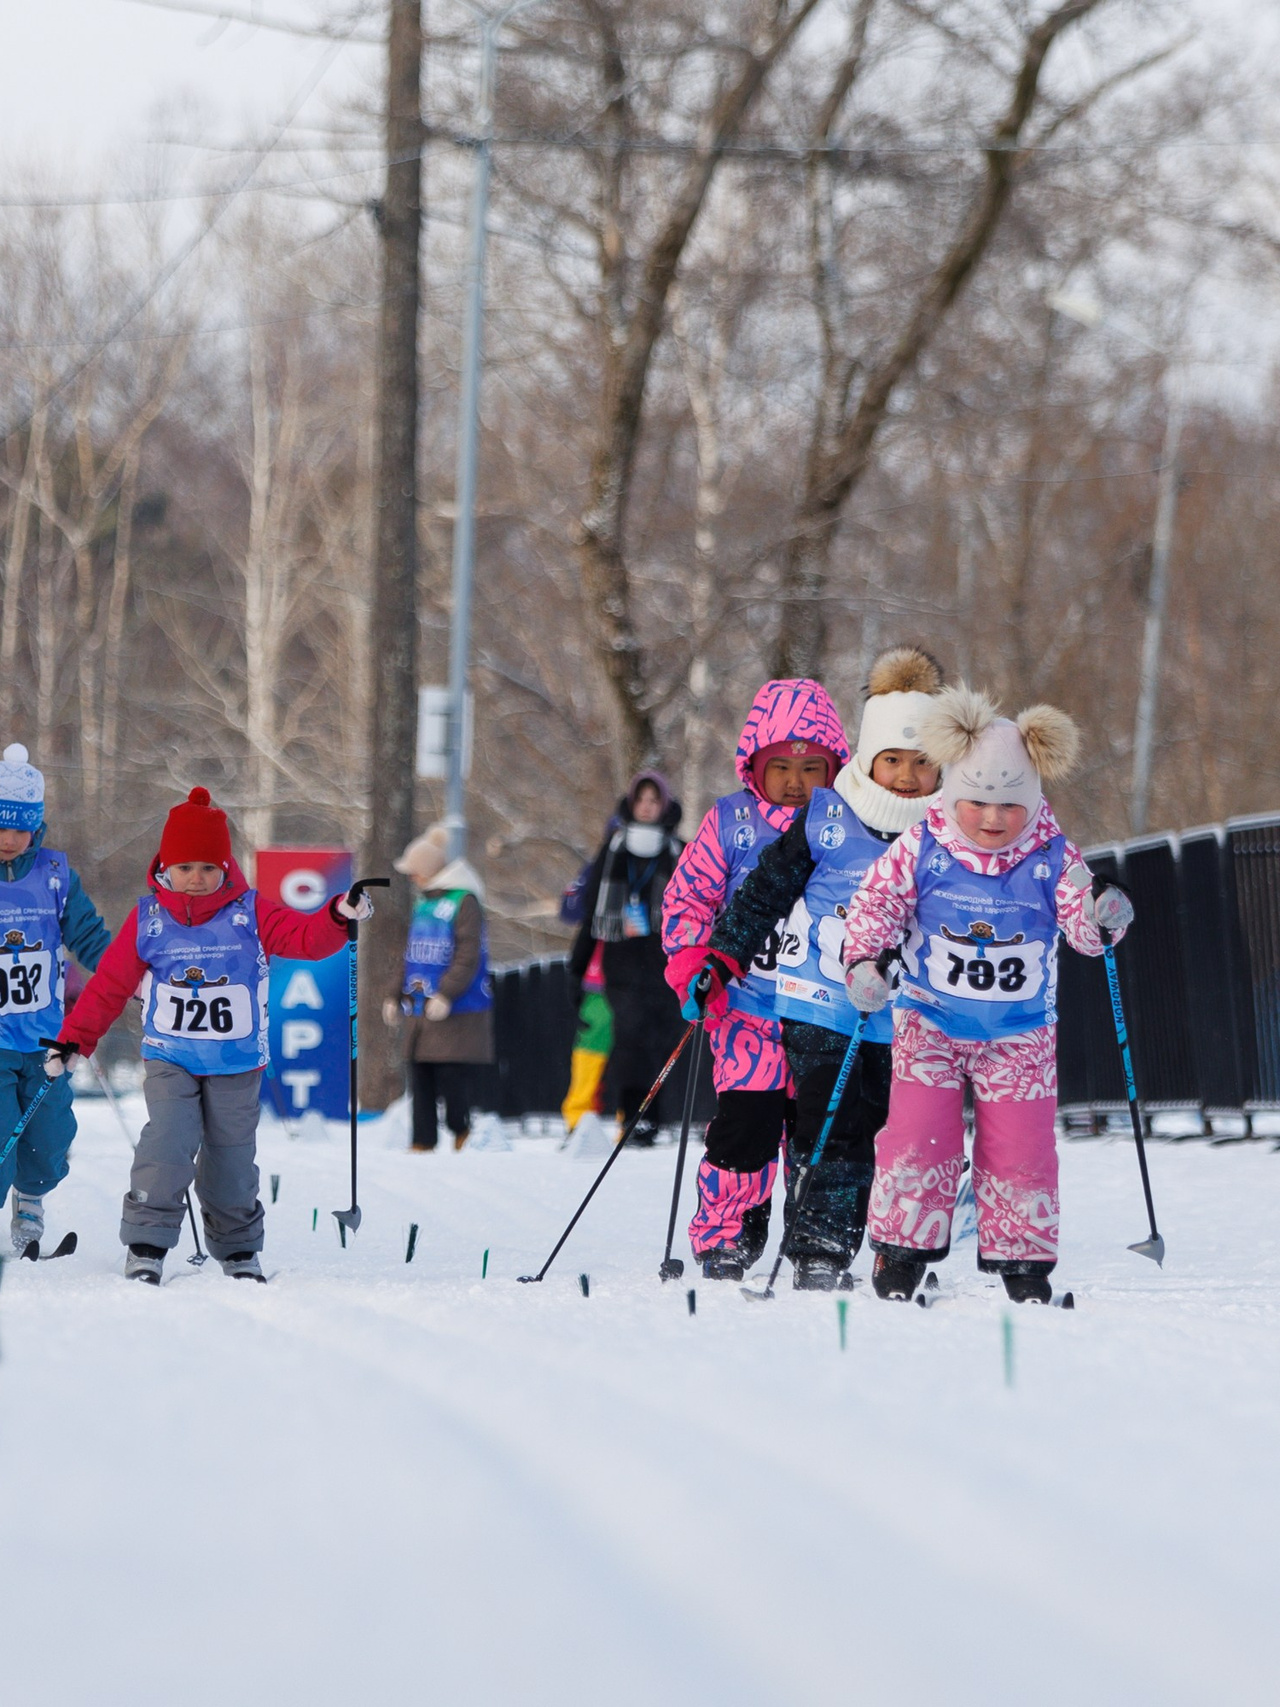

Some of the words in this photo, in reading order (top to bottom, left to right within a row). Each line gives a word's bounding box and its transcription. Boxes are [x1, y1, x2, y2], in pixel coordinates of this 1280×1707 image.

[278, 868, 326, 1109] САРТ
[947, 951, 1027, 993] 793
[1109, 967, 1125, 1024] NORDWAY
[169, 995, 234, 1034] 726
[835, 1040, 859, 1095] NORDWAY
